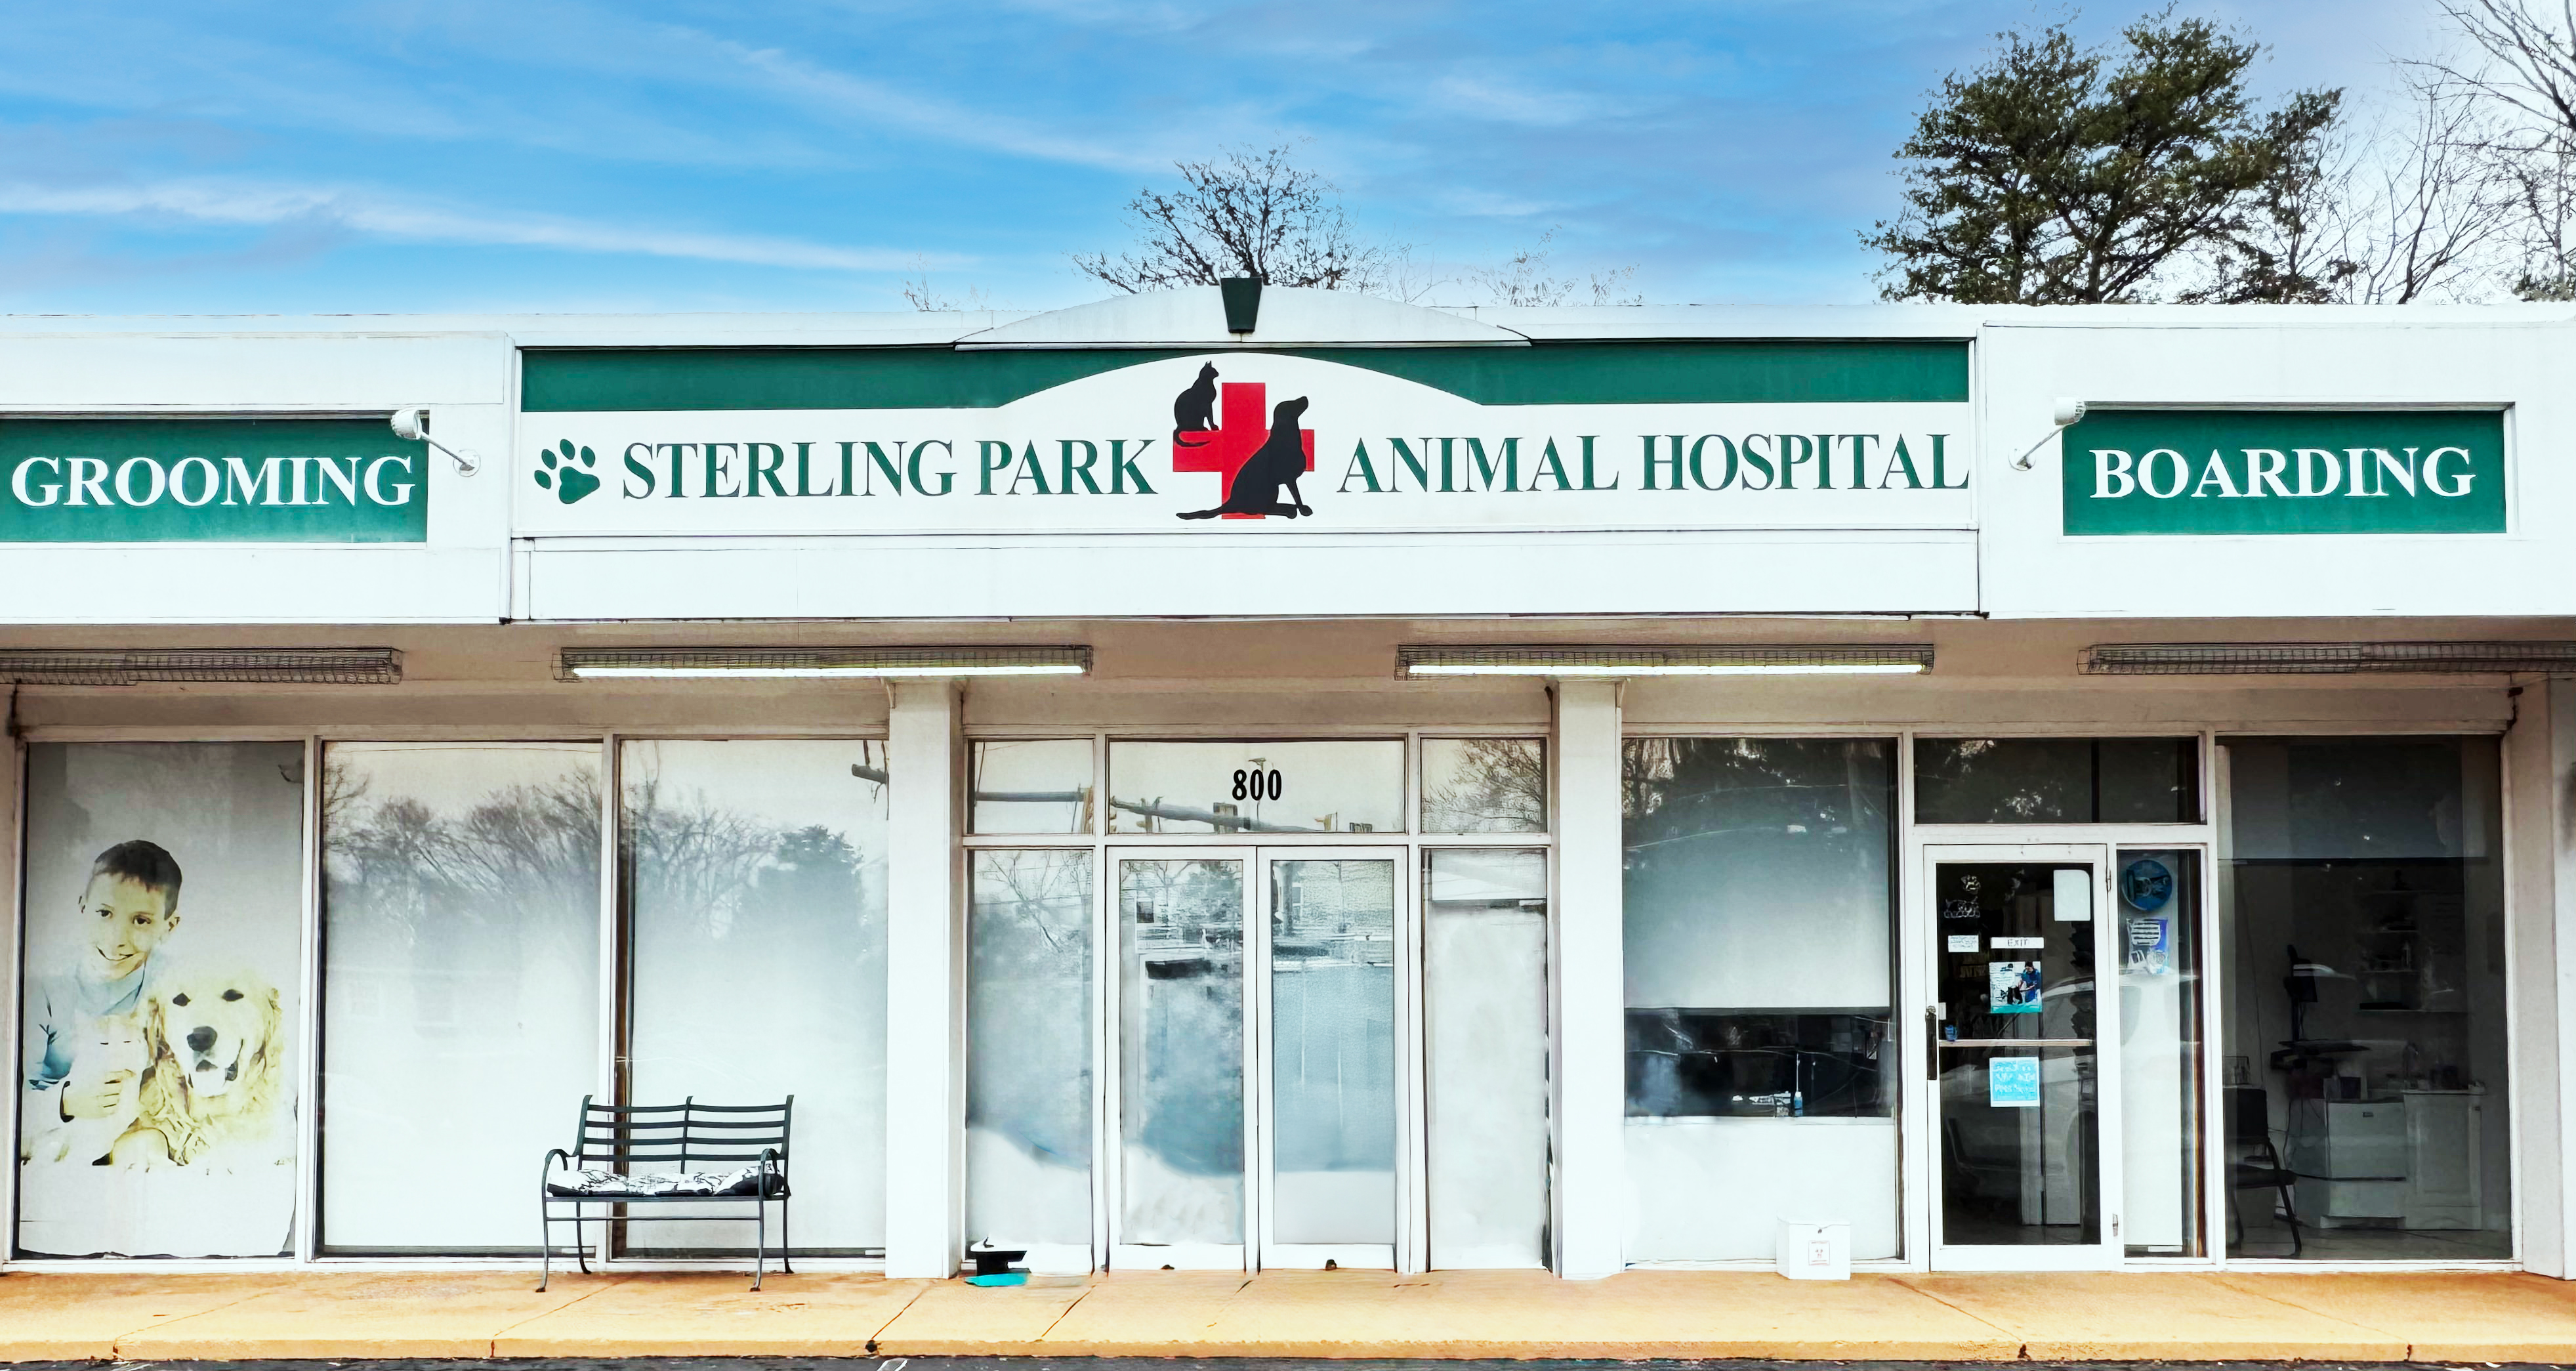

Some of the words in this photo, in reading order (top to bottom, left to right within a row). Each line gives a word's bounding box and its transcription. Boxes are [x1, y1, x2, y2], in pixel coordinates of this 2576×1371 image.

[11, 456, 415, 507] GROOMING
[623, 440, 957, 499] STERLING
[975, 439, 1158, 496] PARK
[1336, 435, 1619, 493] ANIMAL
[1638, 433, 1969, 491] HOSPITAL
[2088, 446, 2476, 499] BOARDING
[1232, 769, 1282, 801] 800
[2007, 939, 2029, 947] EXIT
